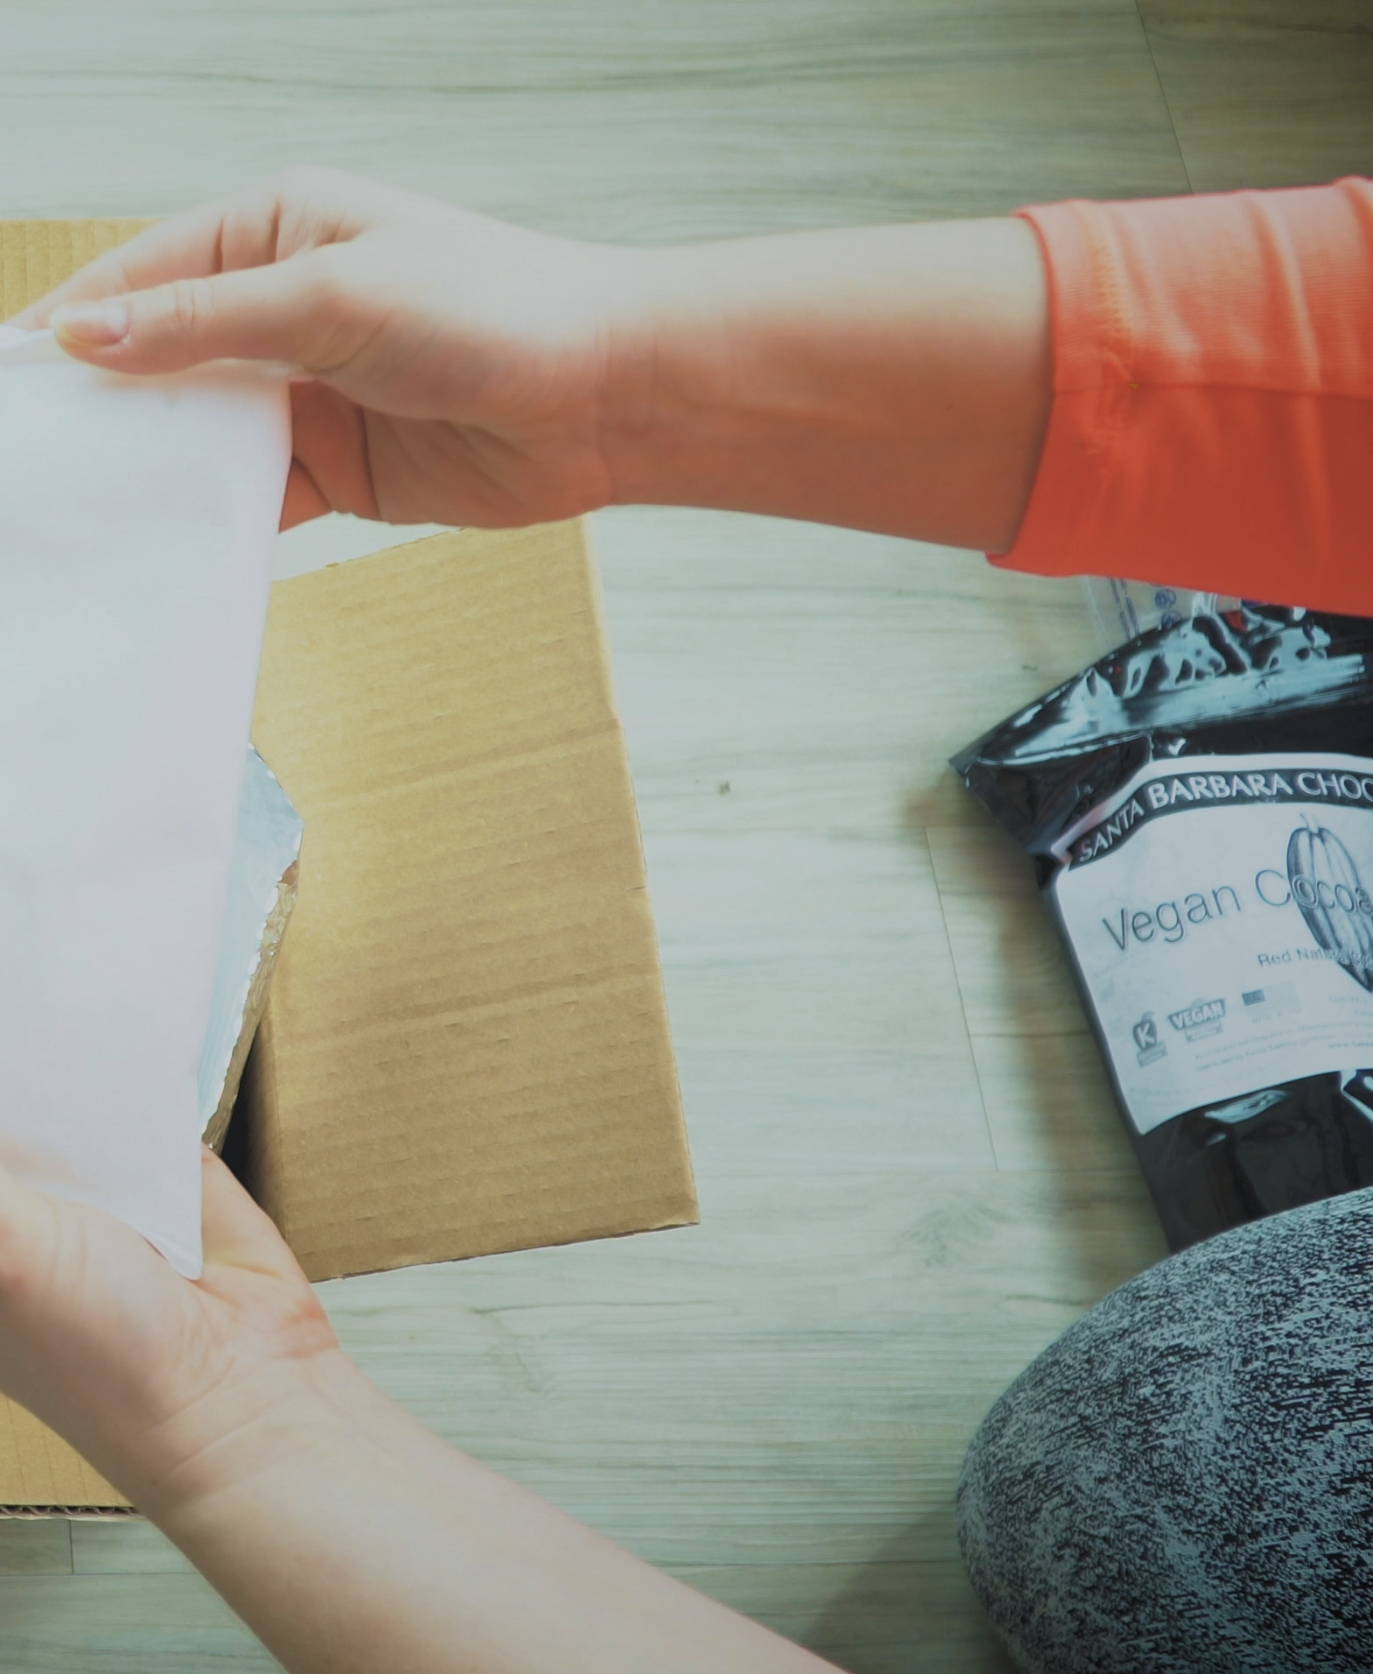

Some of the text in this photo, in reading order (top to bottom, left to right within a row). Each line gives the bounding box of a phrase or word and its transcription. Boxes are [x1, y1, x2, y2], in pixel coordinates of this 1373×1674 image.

[1079, 803, 1143, 862] SANTA
[1148, 773, 1294, 810] BARBARA
[1102, 868, 1373, 951] Vegan Cocoa
[1257, 951, 1292, 968] Red
[1171, 1002, 1225, 1030] VEGAN
[1136, 1024, 1155, 1047] K
